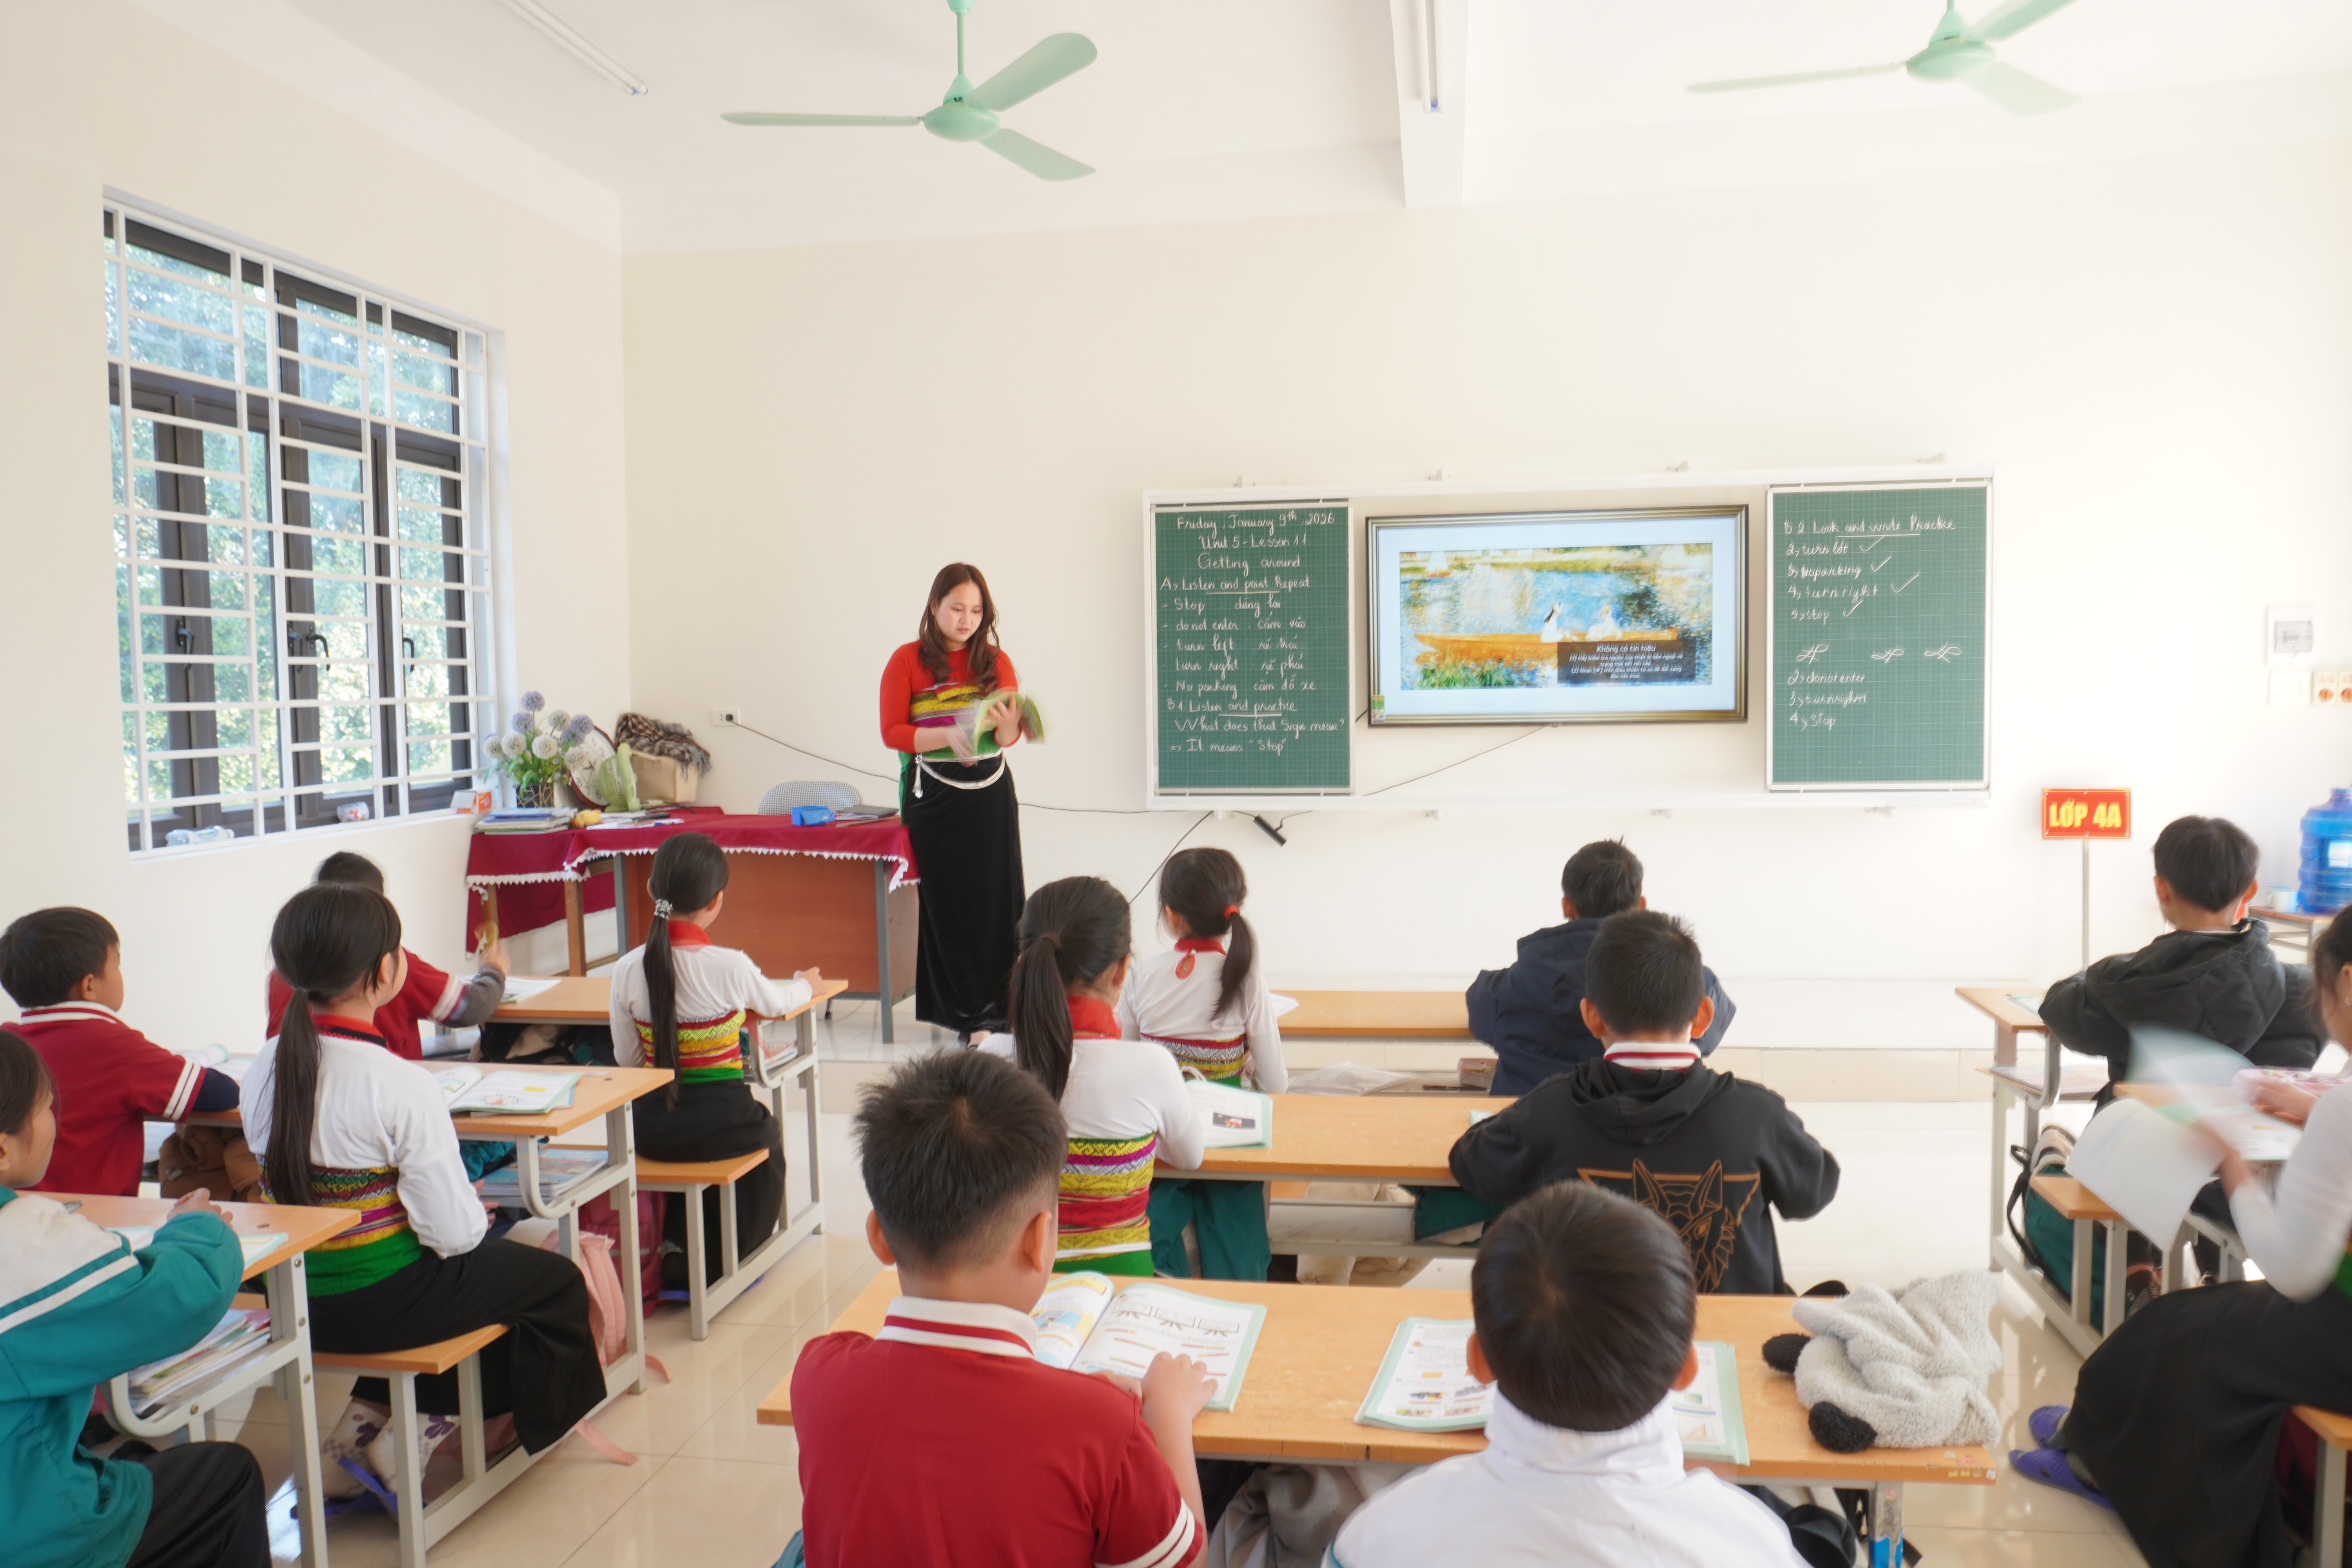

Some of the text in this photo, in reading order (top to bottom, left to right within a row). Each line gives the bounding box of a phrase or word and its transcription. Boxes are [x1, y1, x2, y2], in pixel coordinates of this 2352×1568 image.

[1229, 514, 1274, 536] January
[1813, 519, 1839, 534] Look
[1845, 518, 1864, 532] and
[1869, 515, 1901, 532] write
[1910, 512, 1956, 531] Practice
[1198, 534, 1228, 550] Unit
[1232, 536, 1240, 548] 5
[1251, 532, 1289, 548] Lesson
[1802, 543, 1829, 555] turn
[1832, 539, 1848, 554] left
[1198, 552, 1300, 577] Getting around
[1182, 575, 1215, 590] Listen
[1220, 577, 1238, 589] and
[1245, 575, 1269, 595] point
[1275, 574, 1309, 592] Repeat
[1174, 596, 1205, 616] Stop
[1212, 615, 1240, 630] enter
[1176, 636, 1205, 651] turn
[1212, 634, 1234, 657] left
[1176, 656, 1201, 671] turn
[1208, 654, 1239, 681] right
[1177, 679, 1193, 691] No
[1198, 678, 1238, 699] parking
[1300, 682, 1316, 691] xe
[1189, 698, 1222, 712] Listen
[1228, 697, 1248, 711] and
[1254, 696, 1297, 719] practice
[1174, 714, 1219, 731] What
[1223, 718, 1248, 731] does
[1253, 718, 1276, 731] that
[600, 748, 605, 757] 2
[1186, 737, 1204, 751] It
[1210, 743, 1243, 752] means
[2050, 800, 2122, 827] LỚP 4A
